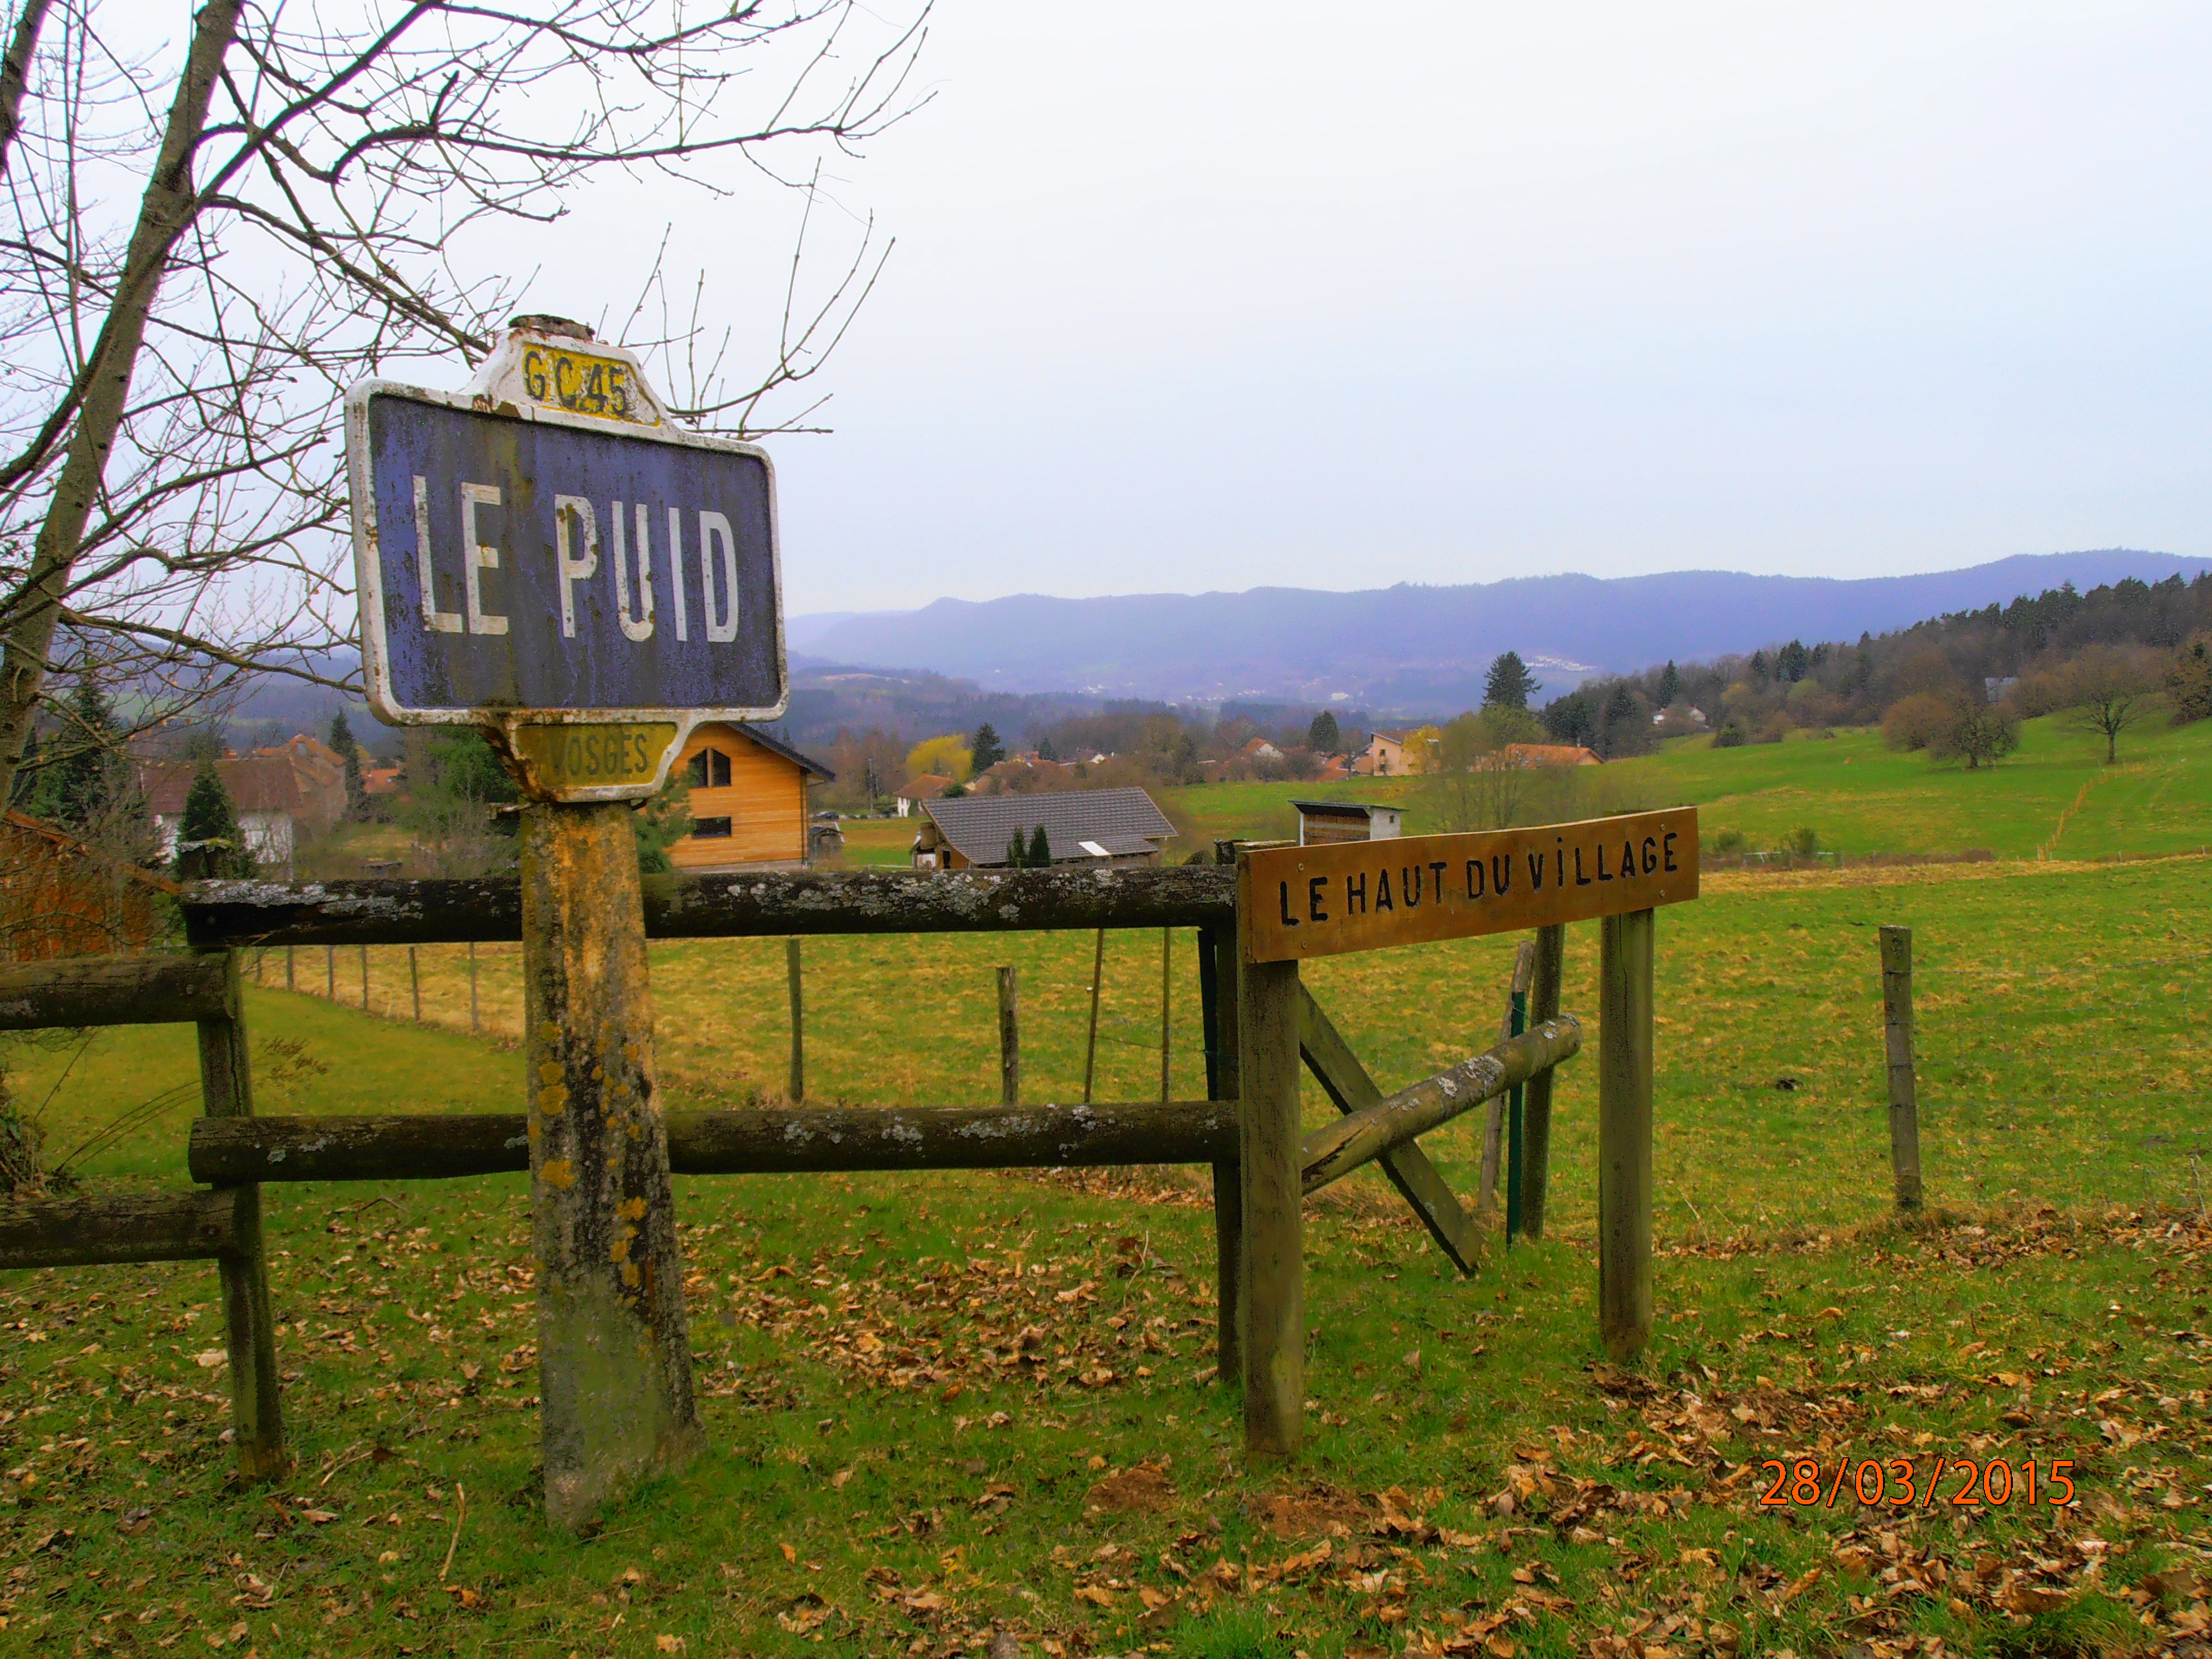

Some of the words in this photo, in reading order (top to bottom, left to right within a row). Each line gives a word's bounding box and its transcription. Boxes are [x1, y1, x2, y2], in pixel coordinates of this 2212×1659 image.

[412, 475, 509, 635] LE
[554, 494, 739, 642] PUID
[551, 733, 647, 776] VOSGES
[1280, 876, 1328, 926] LE
[1347, 862, 1447, 916] HAUT
[1466, 854, 1510, 899] DU
